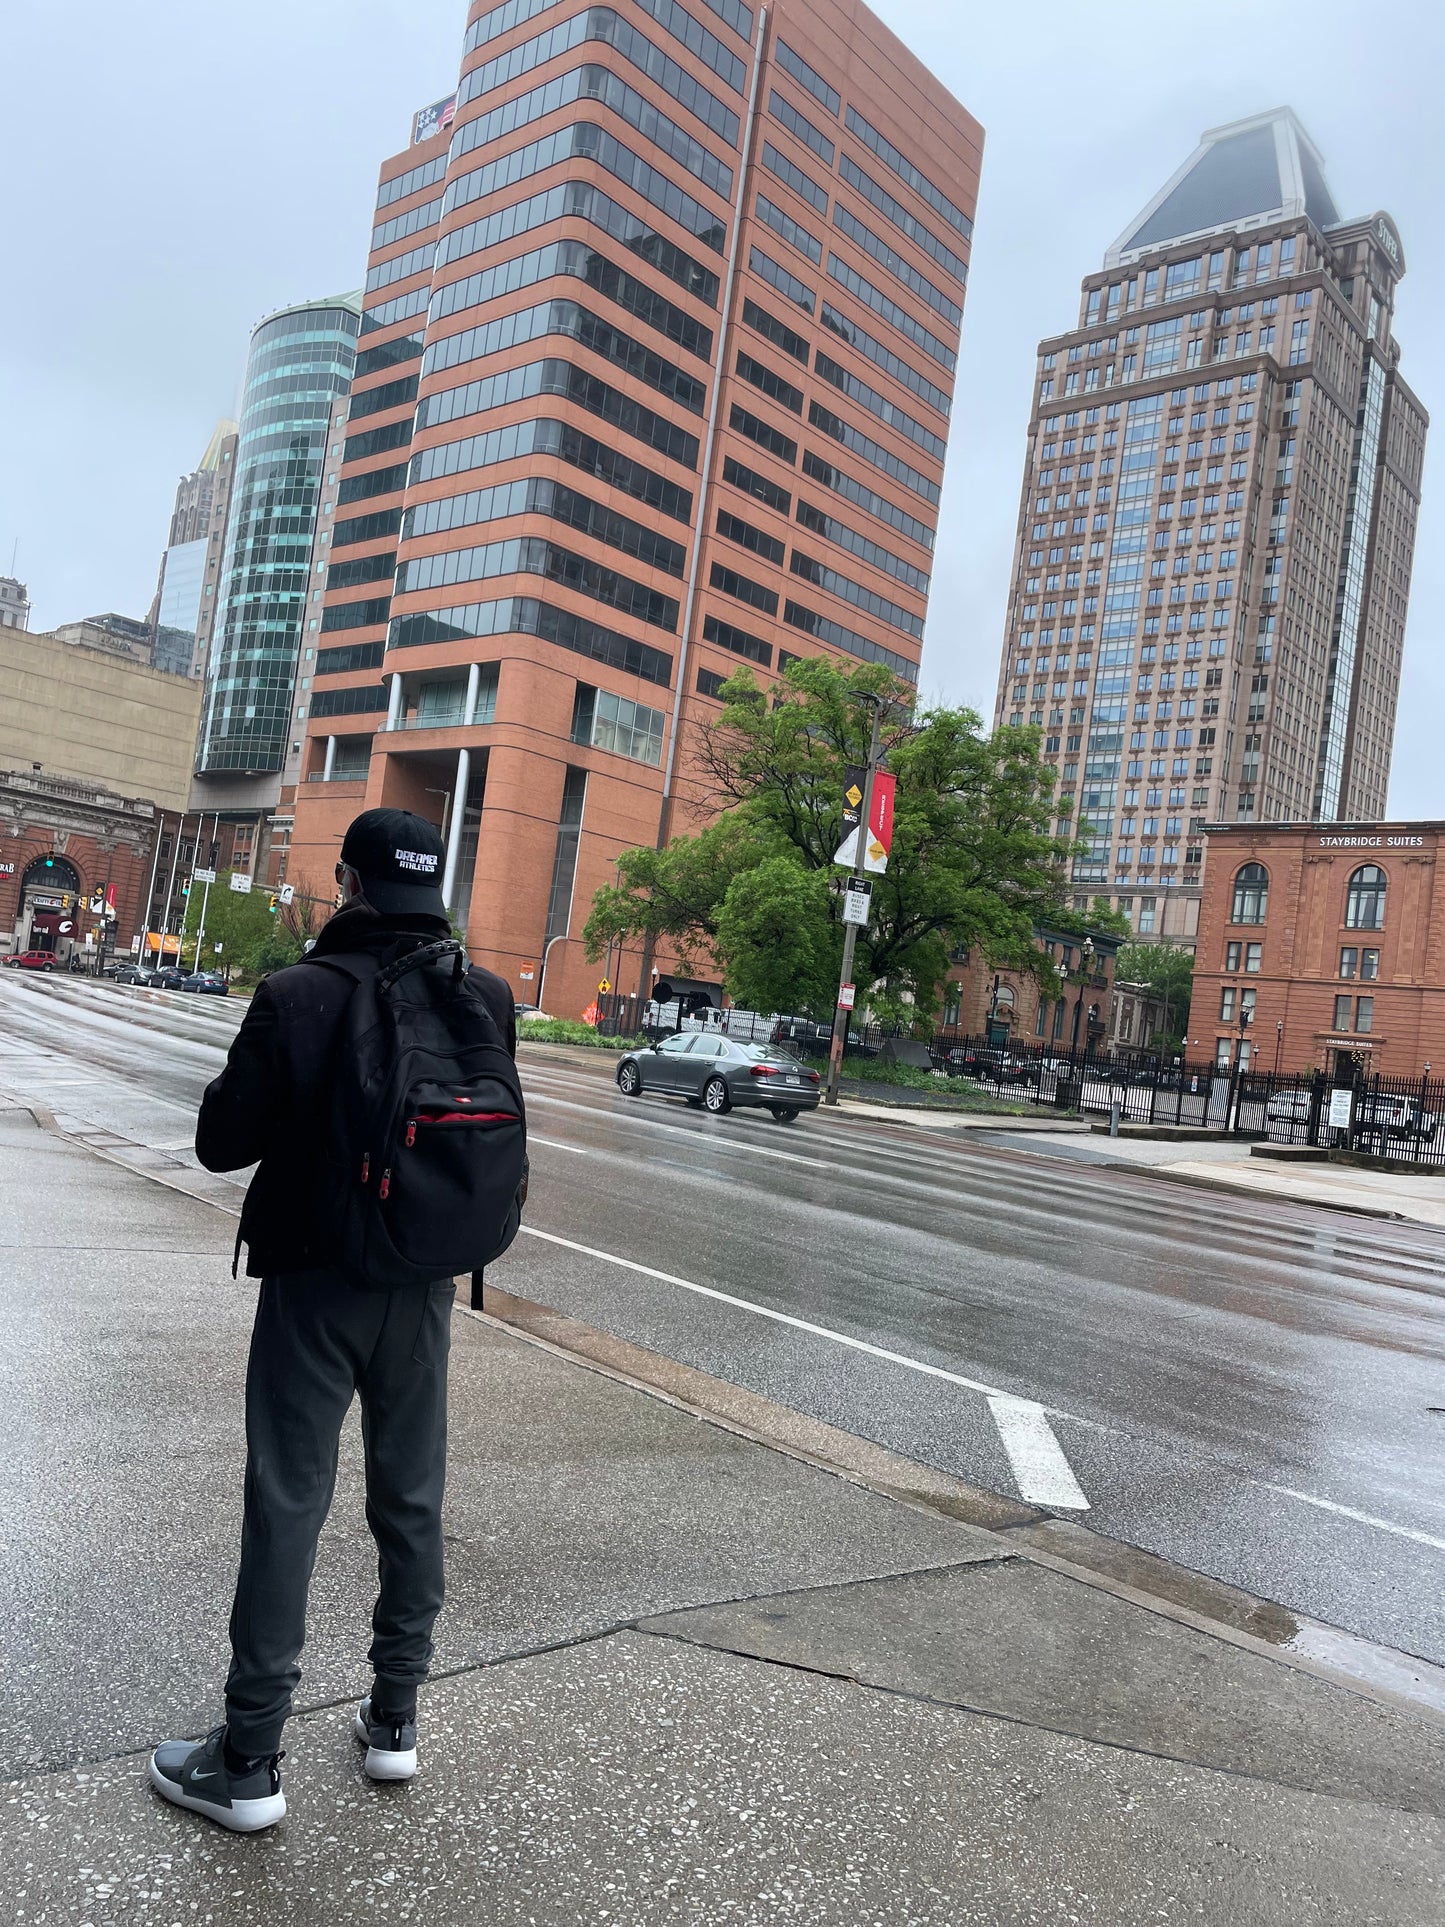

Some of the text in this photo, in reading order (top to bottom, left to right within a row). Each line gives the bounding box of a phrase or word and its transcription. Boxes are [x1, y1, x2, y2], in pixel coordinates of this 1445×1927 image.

[1379, 219, 1398, 262] STIFEL
[1320, 837, 1423, 846] STAYBRIDGE SUITES
[395, 849, 438, 865] DREAMER
[0, 863, 14, 873] RAB
[399, 860, 435, 873] ATHLETICS
